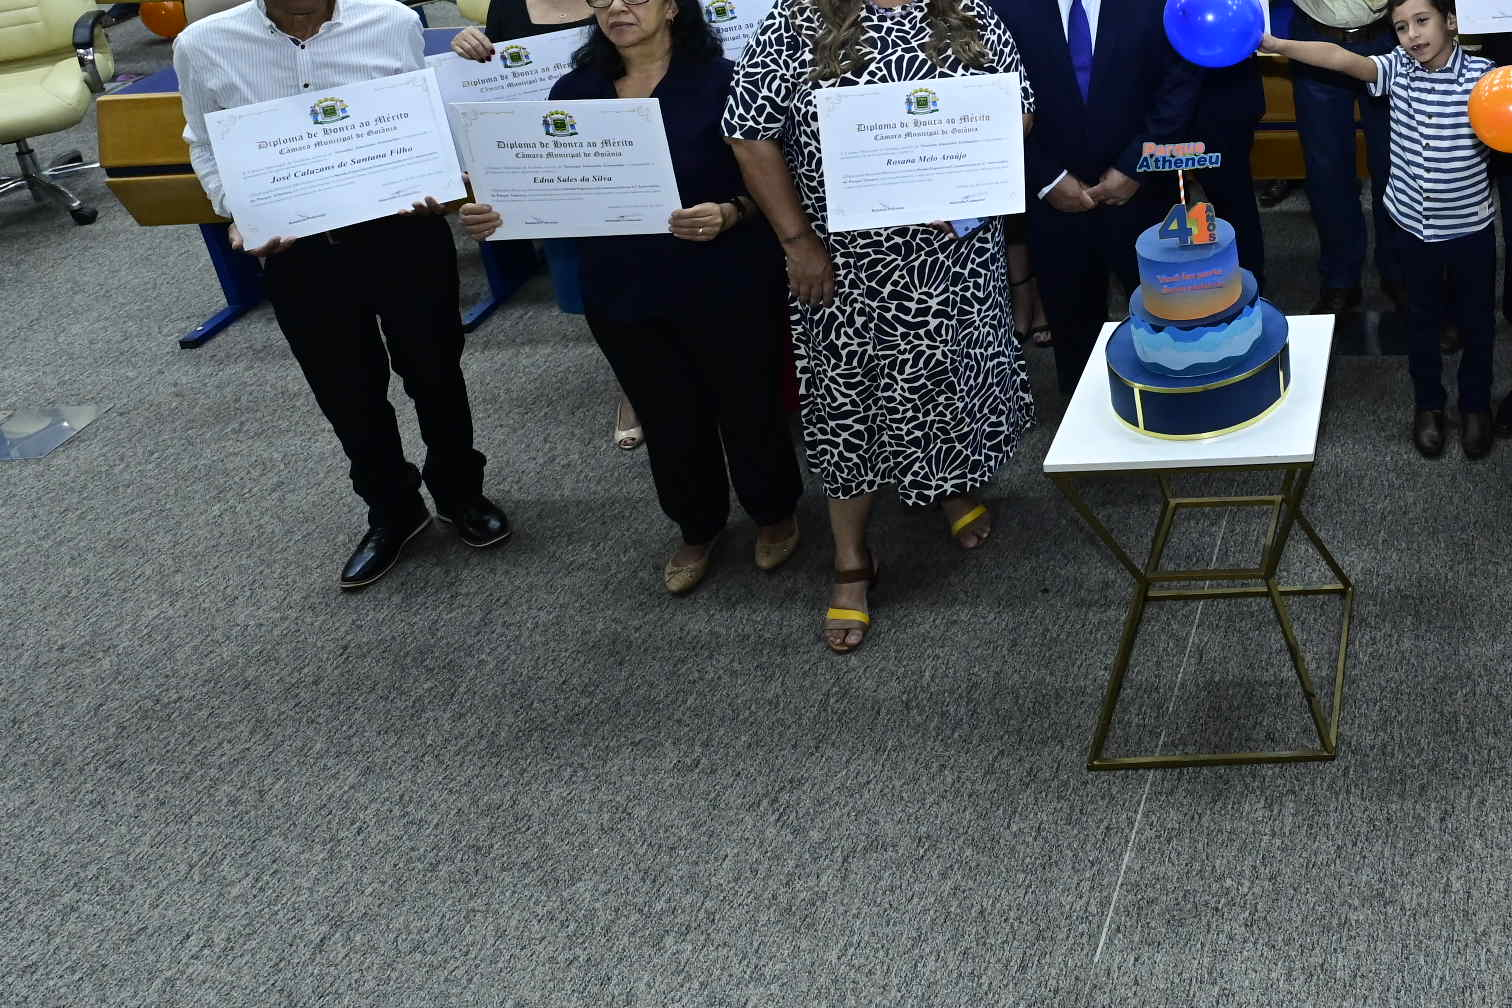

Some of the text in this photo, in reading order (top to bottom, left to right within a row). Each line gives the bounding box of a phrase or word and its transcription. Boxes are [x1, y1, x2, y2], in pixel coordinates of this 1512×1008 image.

[258, 112, 409, 150] Diploma de Honra ao Mérito
[857, 122, 896, 132] Diploma
[913, 119, 942, 127] Honra
[959, 113, 990, 124] Mérito
[496, 141, 537, 150] Diploma
[553, 140, 583, 149] Honra
[601, 139, 633, 148] Mérito
[1143, 143, 1205, 156] Parque
[546, 151, 581, 160] Municipal
[886, 152, 967, 166] Rosana Melo Araújo
[1137, 154, 1221, 171] Atheneu
[272, 173, 291, 184] José
[337, 160, 348, 168] de
[351, 152, 386, 166] Santana
[390, 147, 413, 157] Filho
[533, 176, 554, 184] Edna
[1159, 203, 1216, 246] 41
[1205, 205, 1216, 241] ANOS
